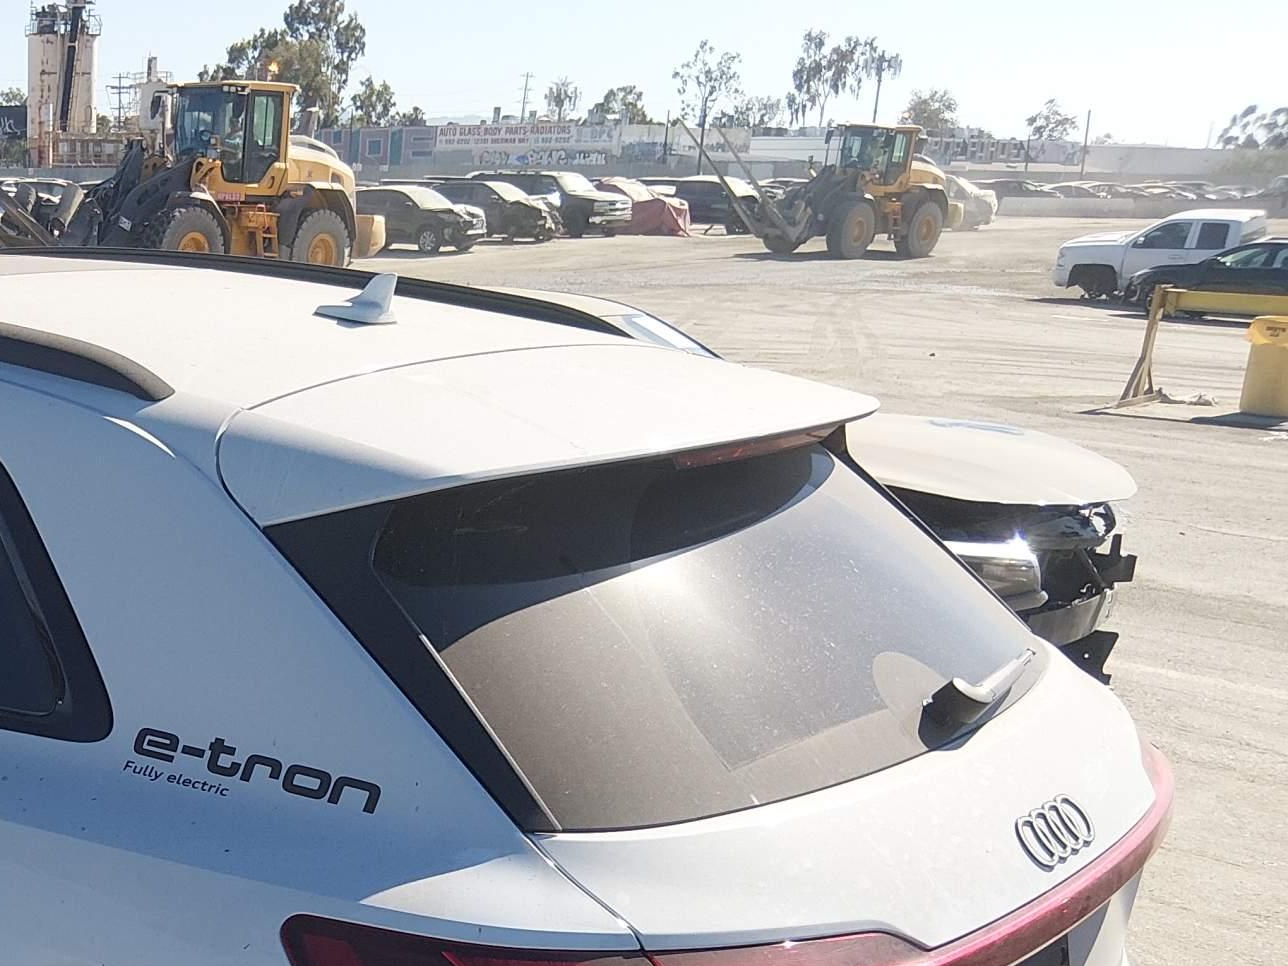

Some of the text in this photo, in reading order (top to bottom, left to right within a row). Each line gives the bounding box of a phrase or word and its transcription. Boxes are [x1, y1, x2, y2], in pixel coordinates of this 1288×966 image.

[439, 127, 457, 137] AUTO
[459, 127, 481, 137] GLASS
[483, 126, 502, 136] BODY
[505, 126, 527, 136] PARTS
[530, 125, 571, 135] RADIATORS
[122, 760, 230, 797] Fully electric
[133, 727, 381, 814] e-tron
